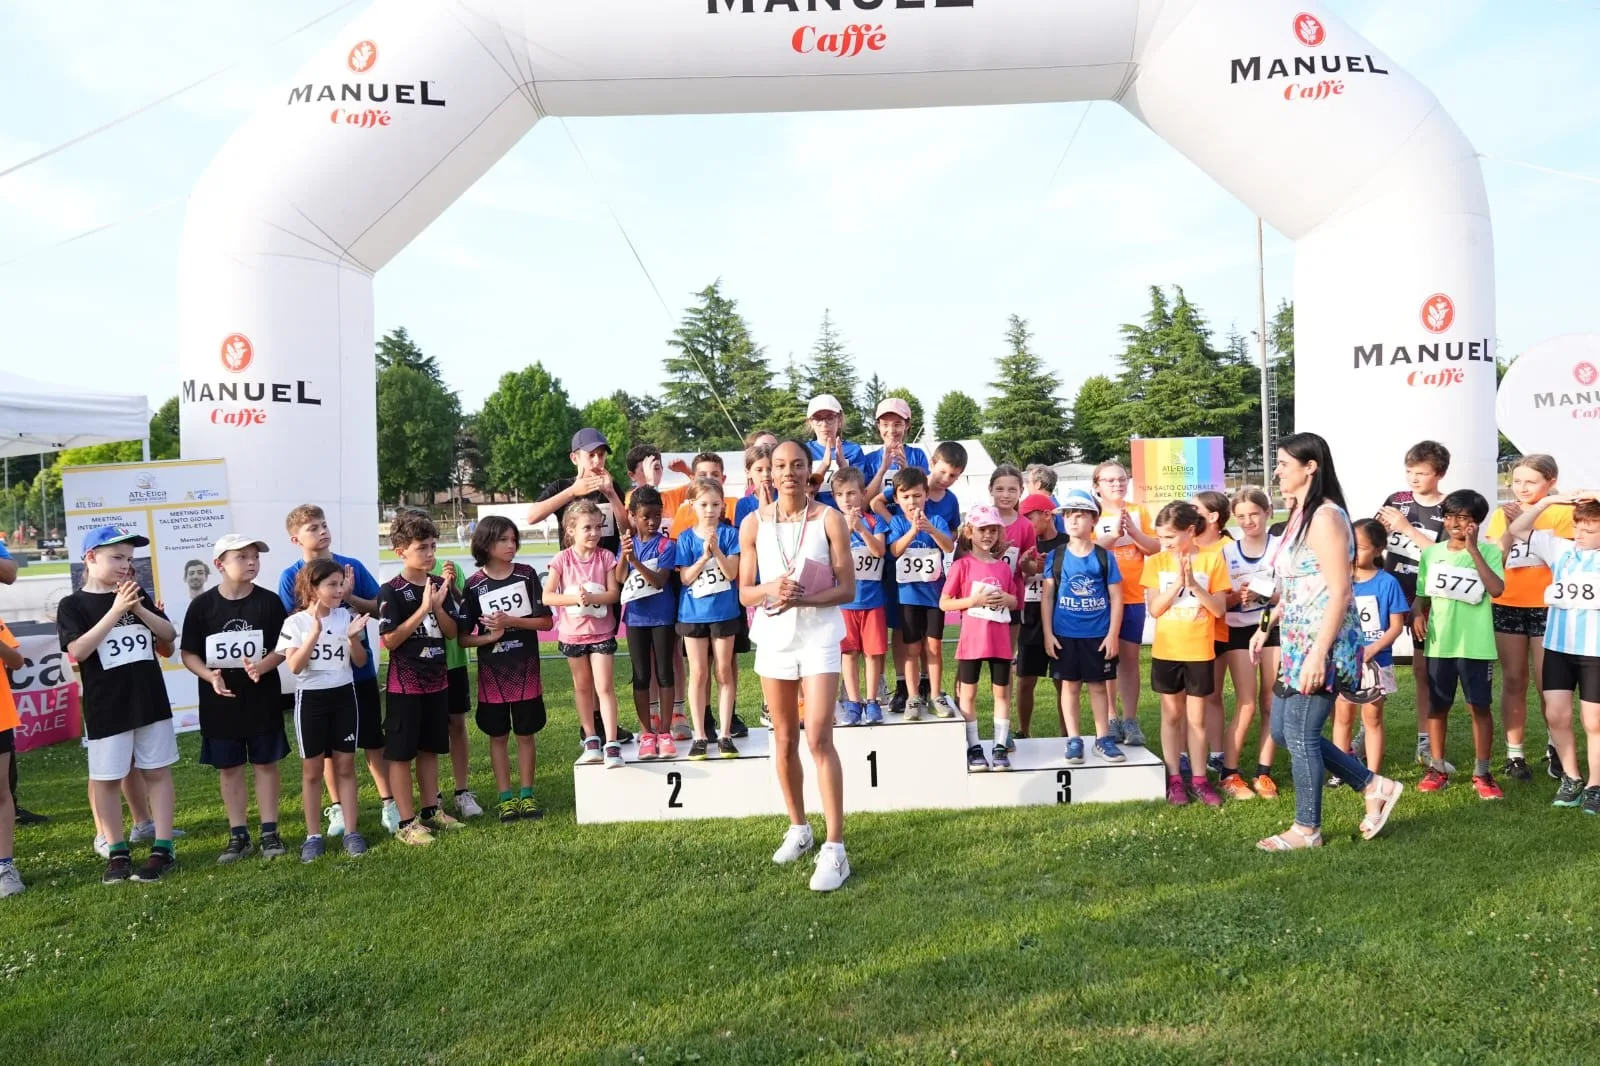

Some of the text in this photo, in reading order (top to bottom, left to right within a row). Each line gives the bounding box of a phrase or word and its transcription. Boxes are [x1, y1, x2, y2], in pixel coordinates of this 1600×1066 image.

[791, 24, 887, 57] Caffé
[1231, 54, 1389, 85] MANUEL
[288, 80, 446, 107] MANUEL
[1284, 80, 1345, 101] Caffé
[330, 108, 392, 128] Caffé
[1353, 338, 1494, 371] MANUEL
[1406, 368, 1465, 387] Caffé
[182, 380, 322, 406] MANUEL
[210, 407, 267, 428] Caffé
[170, 509, 199, 517] MEETING
[856, 556, 881, 572] 397
[904, 558, 935, 574] 393
[1435, 573, 1478, 594] 577
[1554, 582, 1595, 600] 398
[489, 592, 523, 612] 559
[1059, 596, 1106, 608] ATL-Etica
[106, 634, 147, 657] 399
[215, 641, 256, 660] 560
[866, 751, 877, 788] 1
[667, 771, 682, 808] 2
[1056, 770, 1071, 804] 3
